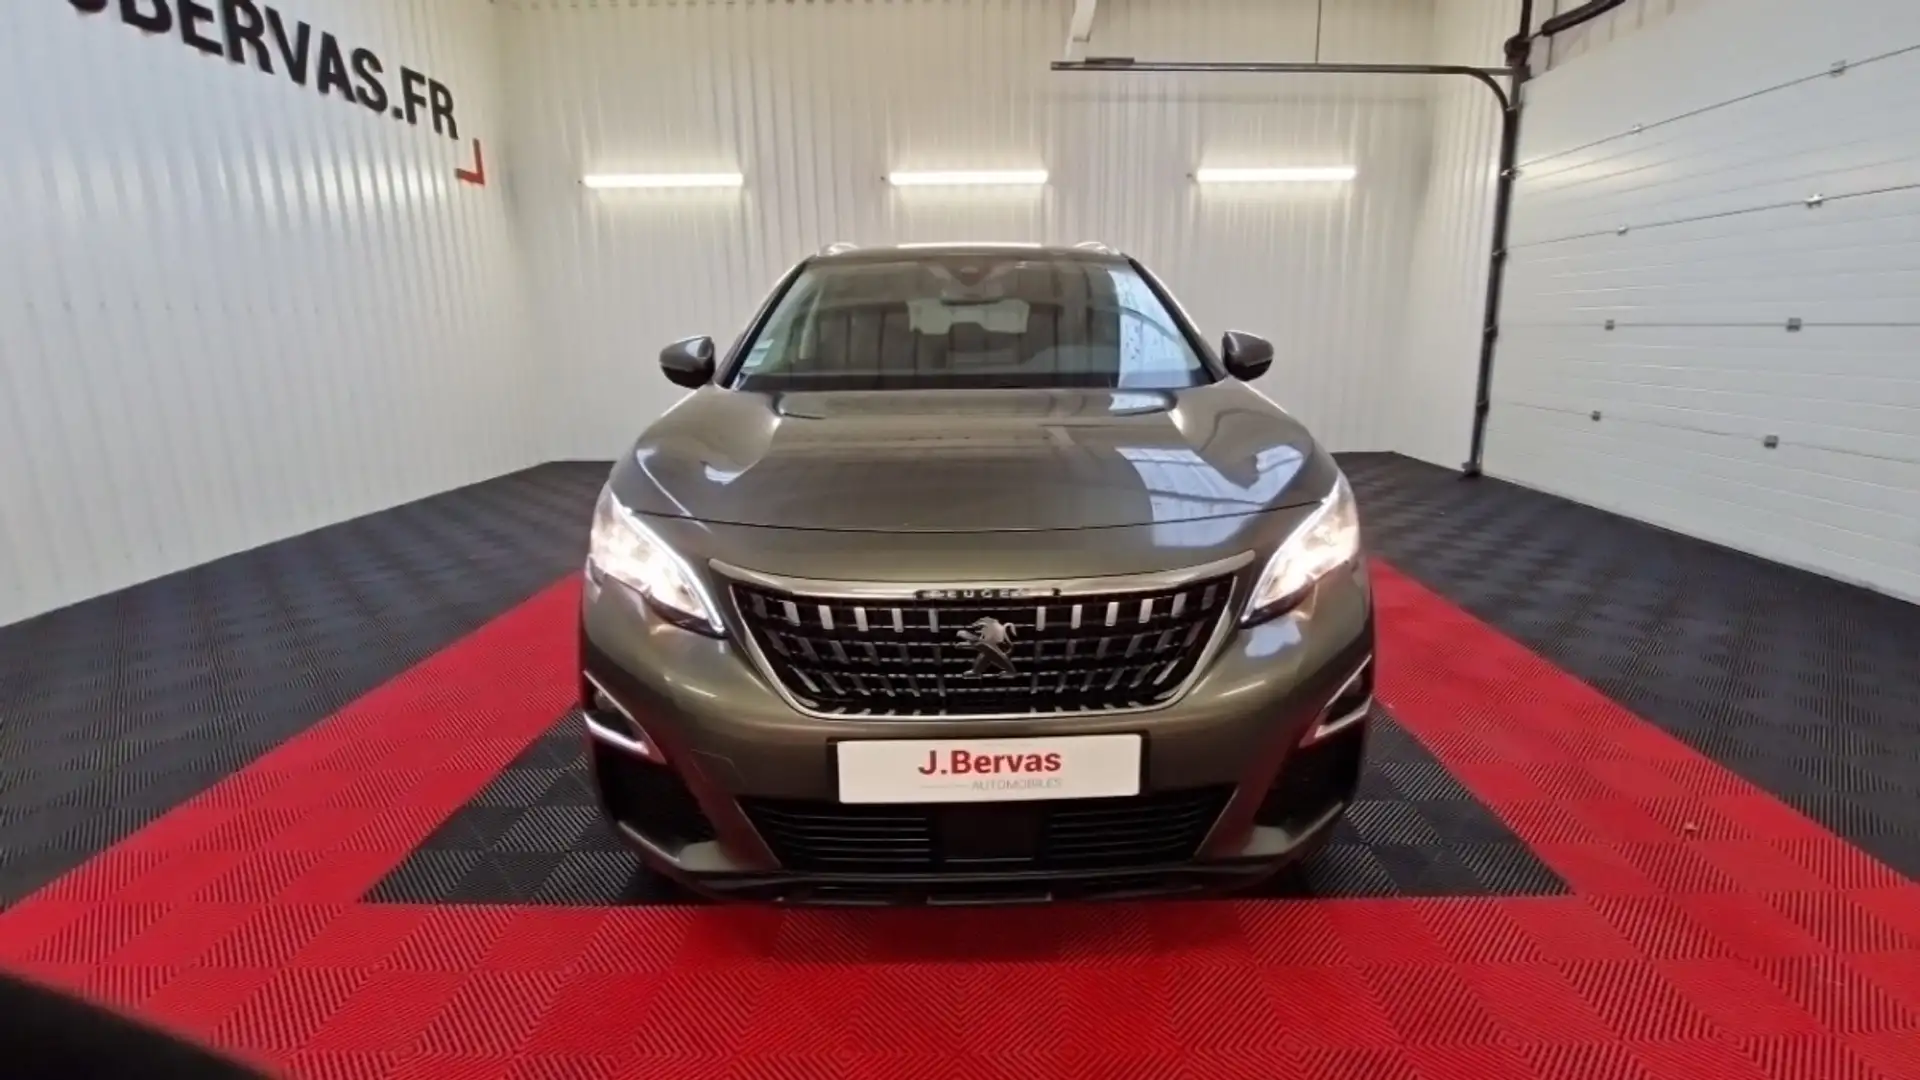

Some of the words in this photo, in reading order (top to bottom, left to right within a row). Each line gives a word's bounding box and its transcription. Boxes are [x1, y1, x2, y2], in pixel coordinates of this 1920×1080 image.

[66, 0, 460, 140] ERVAS.FR
[918, 750, 1062, 775] J.Bervas
[971, 778, 1063, 791] AUTOMOBILES
